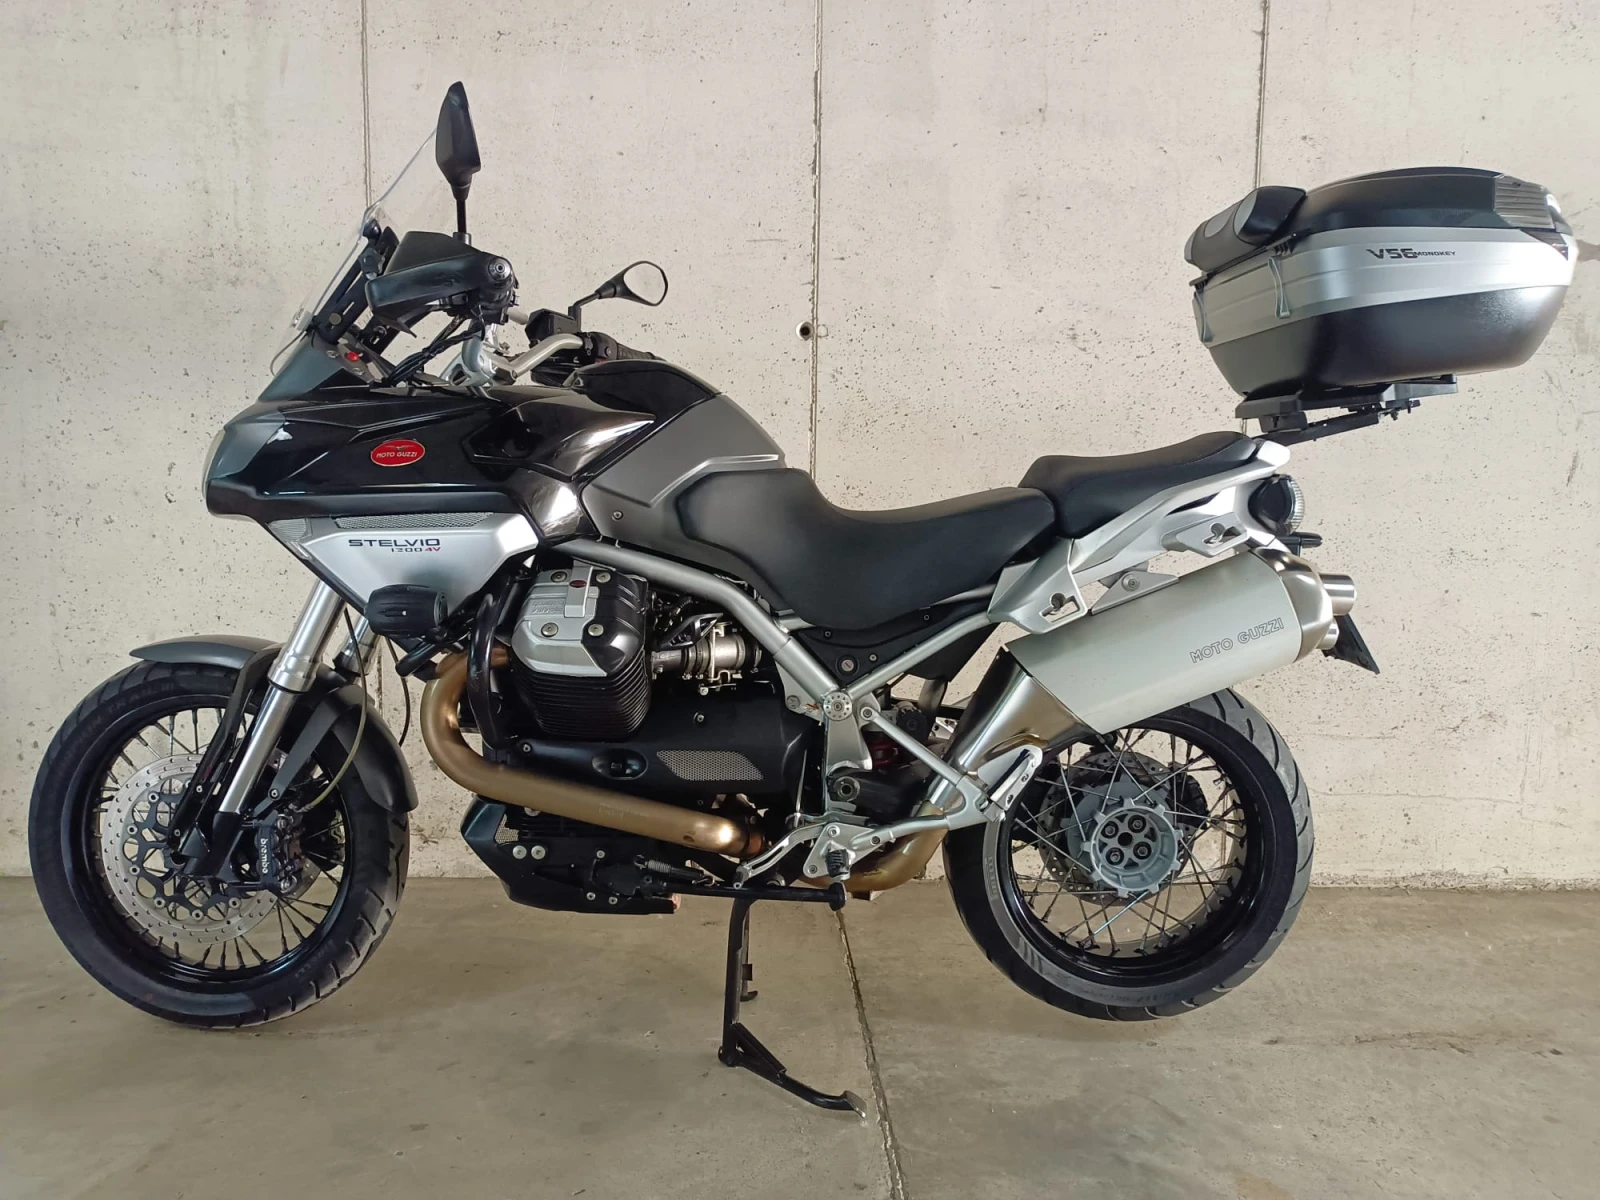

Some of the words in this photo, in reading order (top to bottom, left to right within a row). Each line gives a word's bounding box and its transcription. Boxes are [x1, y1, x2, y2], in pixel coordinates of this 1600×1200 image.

[1366, 248, 1418, 259] V56
[348, 539, 440, 547] STELVIO
[1190, 638, 1233, 663] MOTO
[1237, 617, 1284, 644] GUZZI
[260, 838, 269, 874] brembo
